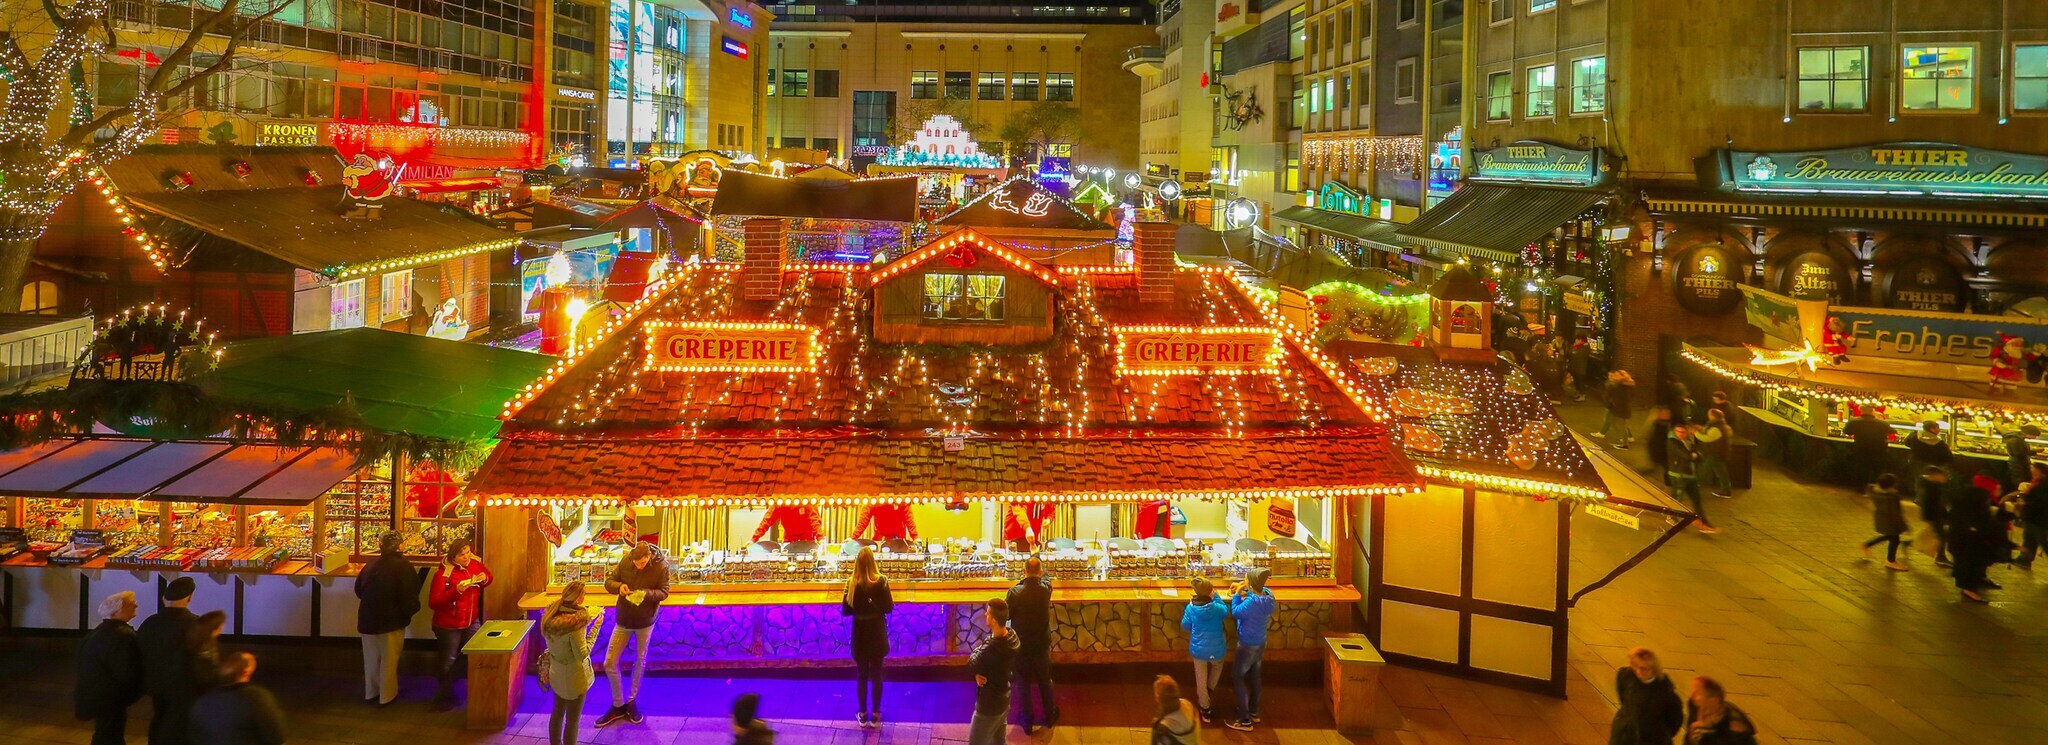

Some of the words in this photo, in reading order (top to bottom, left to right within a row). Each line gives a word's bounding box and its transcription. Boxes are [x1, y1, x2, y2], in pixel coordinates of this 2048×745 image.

[263, 124, 317, 136] KRONEN
[263, 136, 317, 145] PASSAGE
[853, 145, 890, 153] KARSTAD
[1507, 146, 1546, 159] THIER
[1478, 153, 1589, 173] Brauereiausschank
[1871, 149, 1968, 167] THIER
[1801, 263, 1831, 276] Zum
[1682, 277, 1736, 290] THIER
[1794, 275, 1838, 292] Alten
[1696, 288, 1720, 296] PILS
[1897, 290, 1956, 304] THIER
[1912, 302, 1938, 310] PILS
[1850, 320, 1994, 358] Frohes
[669, 331, 794, 362] CRÊPERIE
[1139, 335, 1256, 365] CRÊPERIE
[1269, 513, 1294, 525] nutella
